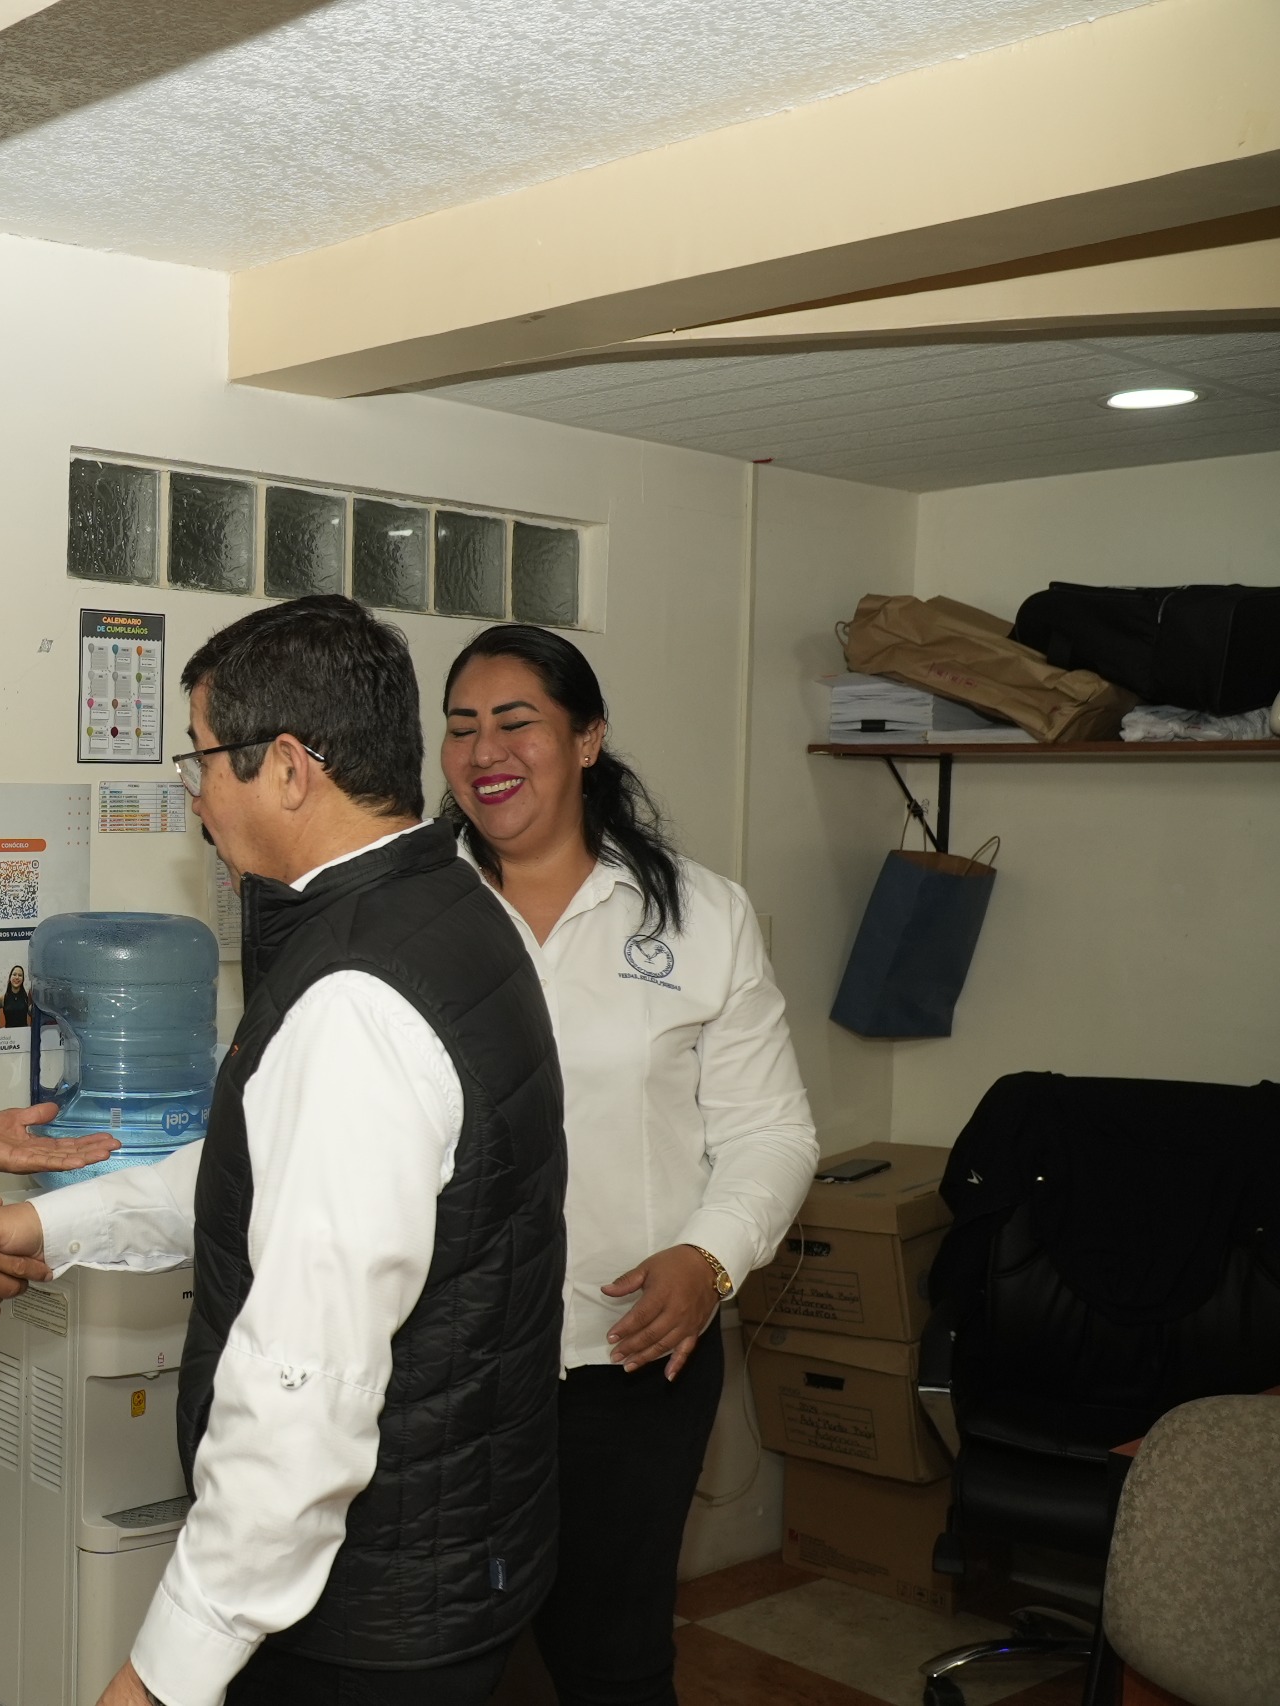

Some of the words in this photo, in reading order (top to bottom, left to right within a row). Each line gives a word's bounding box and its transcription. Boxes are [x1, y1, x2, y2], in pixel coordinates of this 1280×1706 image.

[102, 616, 142, 626] CALENDARIO
[106, 625, 148, 635] CUMPLEAÑOS
[1, 841, 29, 849] CONÓCELO
[166, 1112, 189, 1130] ciel
